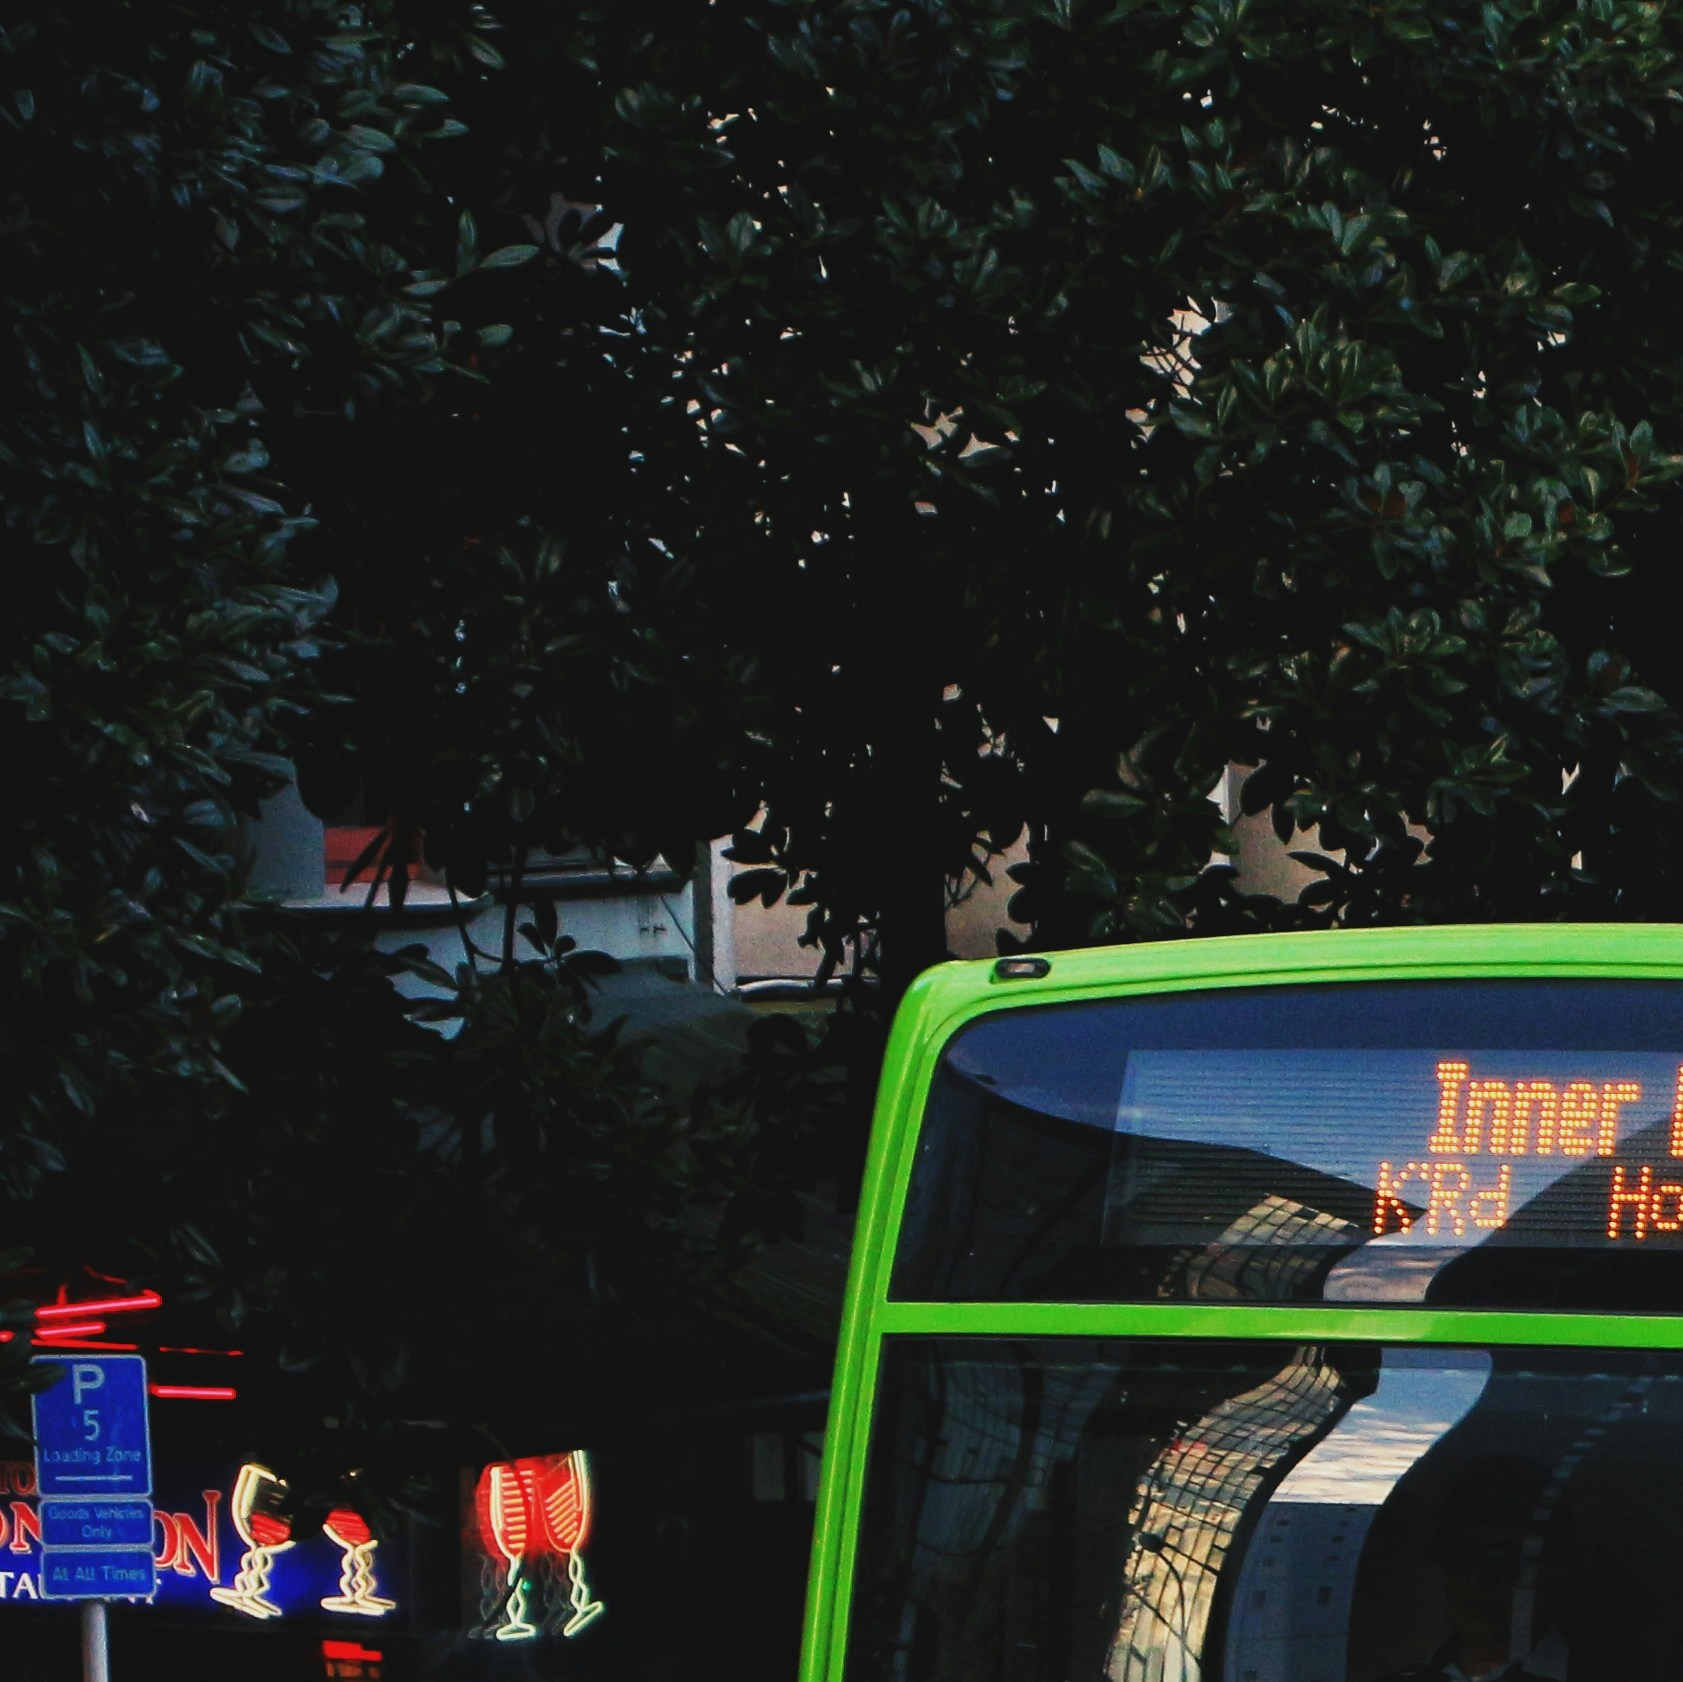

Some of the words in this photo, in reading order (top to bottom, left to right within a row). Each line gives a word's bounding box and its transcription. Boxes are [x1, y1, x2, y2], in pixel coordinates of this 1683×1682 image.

[1428, 1059, 1642, 1156] Inner
[72, 1363, 105, 1405] P
[83, 1409, 100, 1441] 5
[43, 1447, 101, 1465] Loading
[105, 1446, 142, 1463] Zone
[81, 1524, 112, 1539] Only
